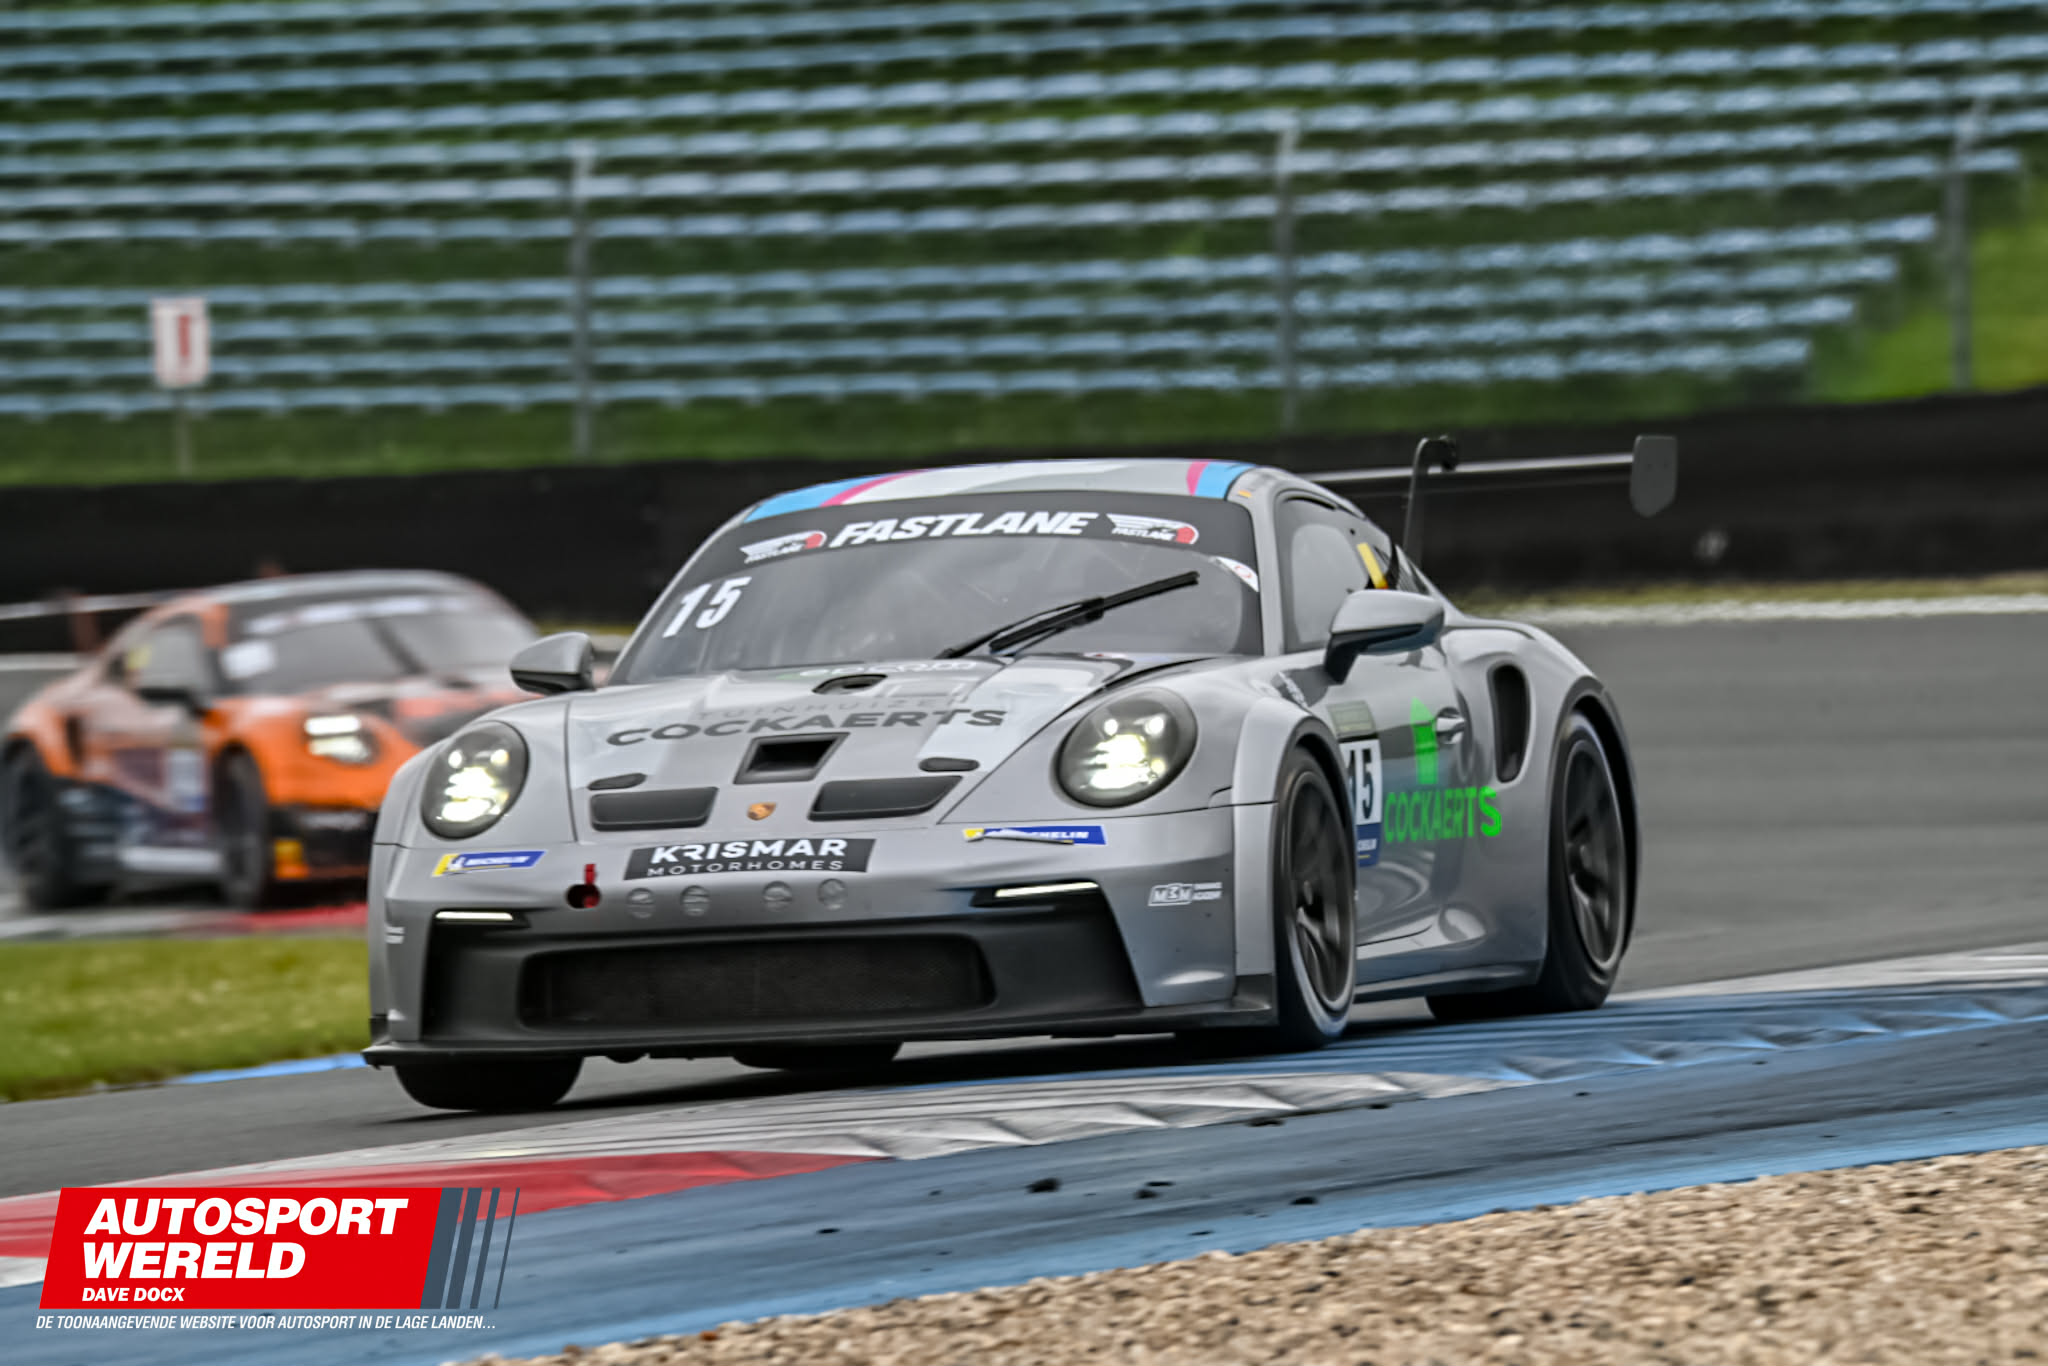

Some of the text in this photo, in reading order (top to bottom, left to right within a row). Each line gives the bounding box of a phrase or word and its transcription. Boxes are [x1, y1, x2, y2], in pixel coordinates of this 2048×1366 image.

[828, 511, 1099, 549] FASTLANE
[662, 576, 753, 639] 15
[606, 708, 1008, 747] COCKAERTS
[1384, 784, 1503, 843] COCKAERTS
[647, 860, 844, 877] MOTORHOMES
[650, 839, 848, 865] KRISMAR
